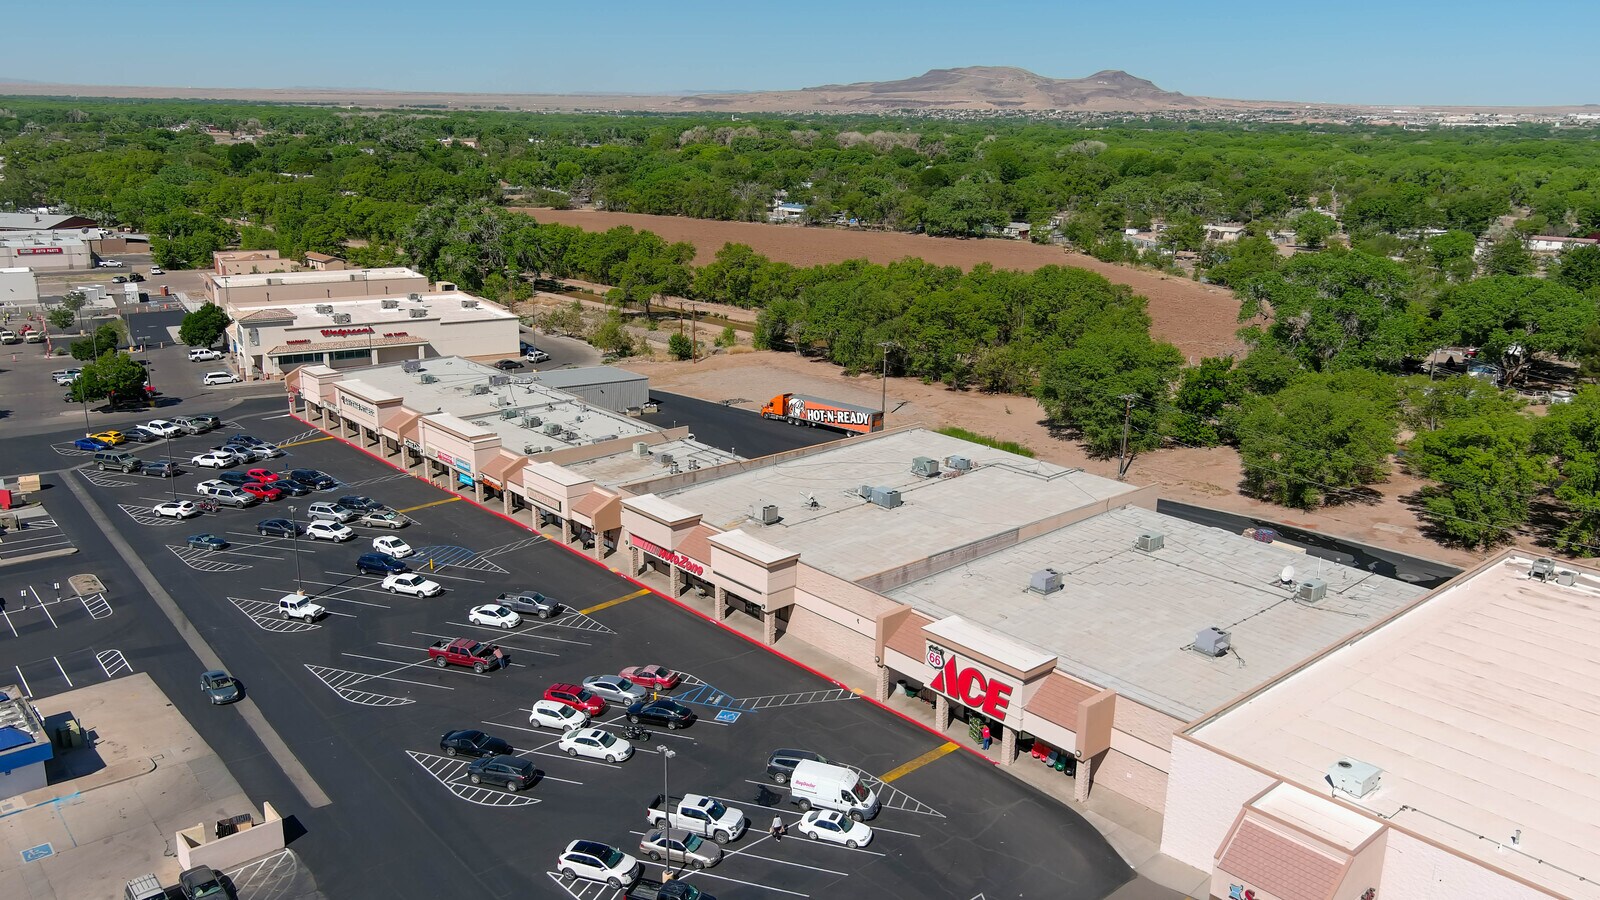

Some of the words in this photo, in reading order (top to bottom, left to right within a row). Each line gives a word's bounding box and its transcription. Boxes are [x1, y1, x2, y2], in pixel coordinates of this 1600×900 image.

[320, 327, 375, 338] Walgreens
[806, 408, 870, 426] HOT-N-READY
[658, 548, 704, 576] AutoZone
[930, 652, 940, 665] 66
[930, 654, 1014, 722] ACE
